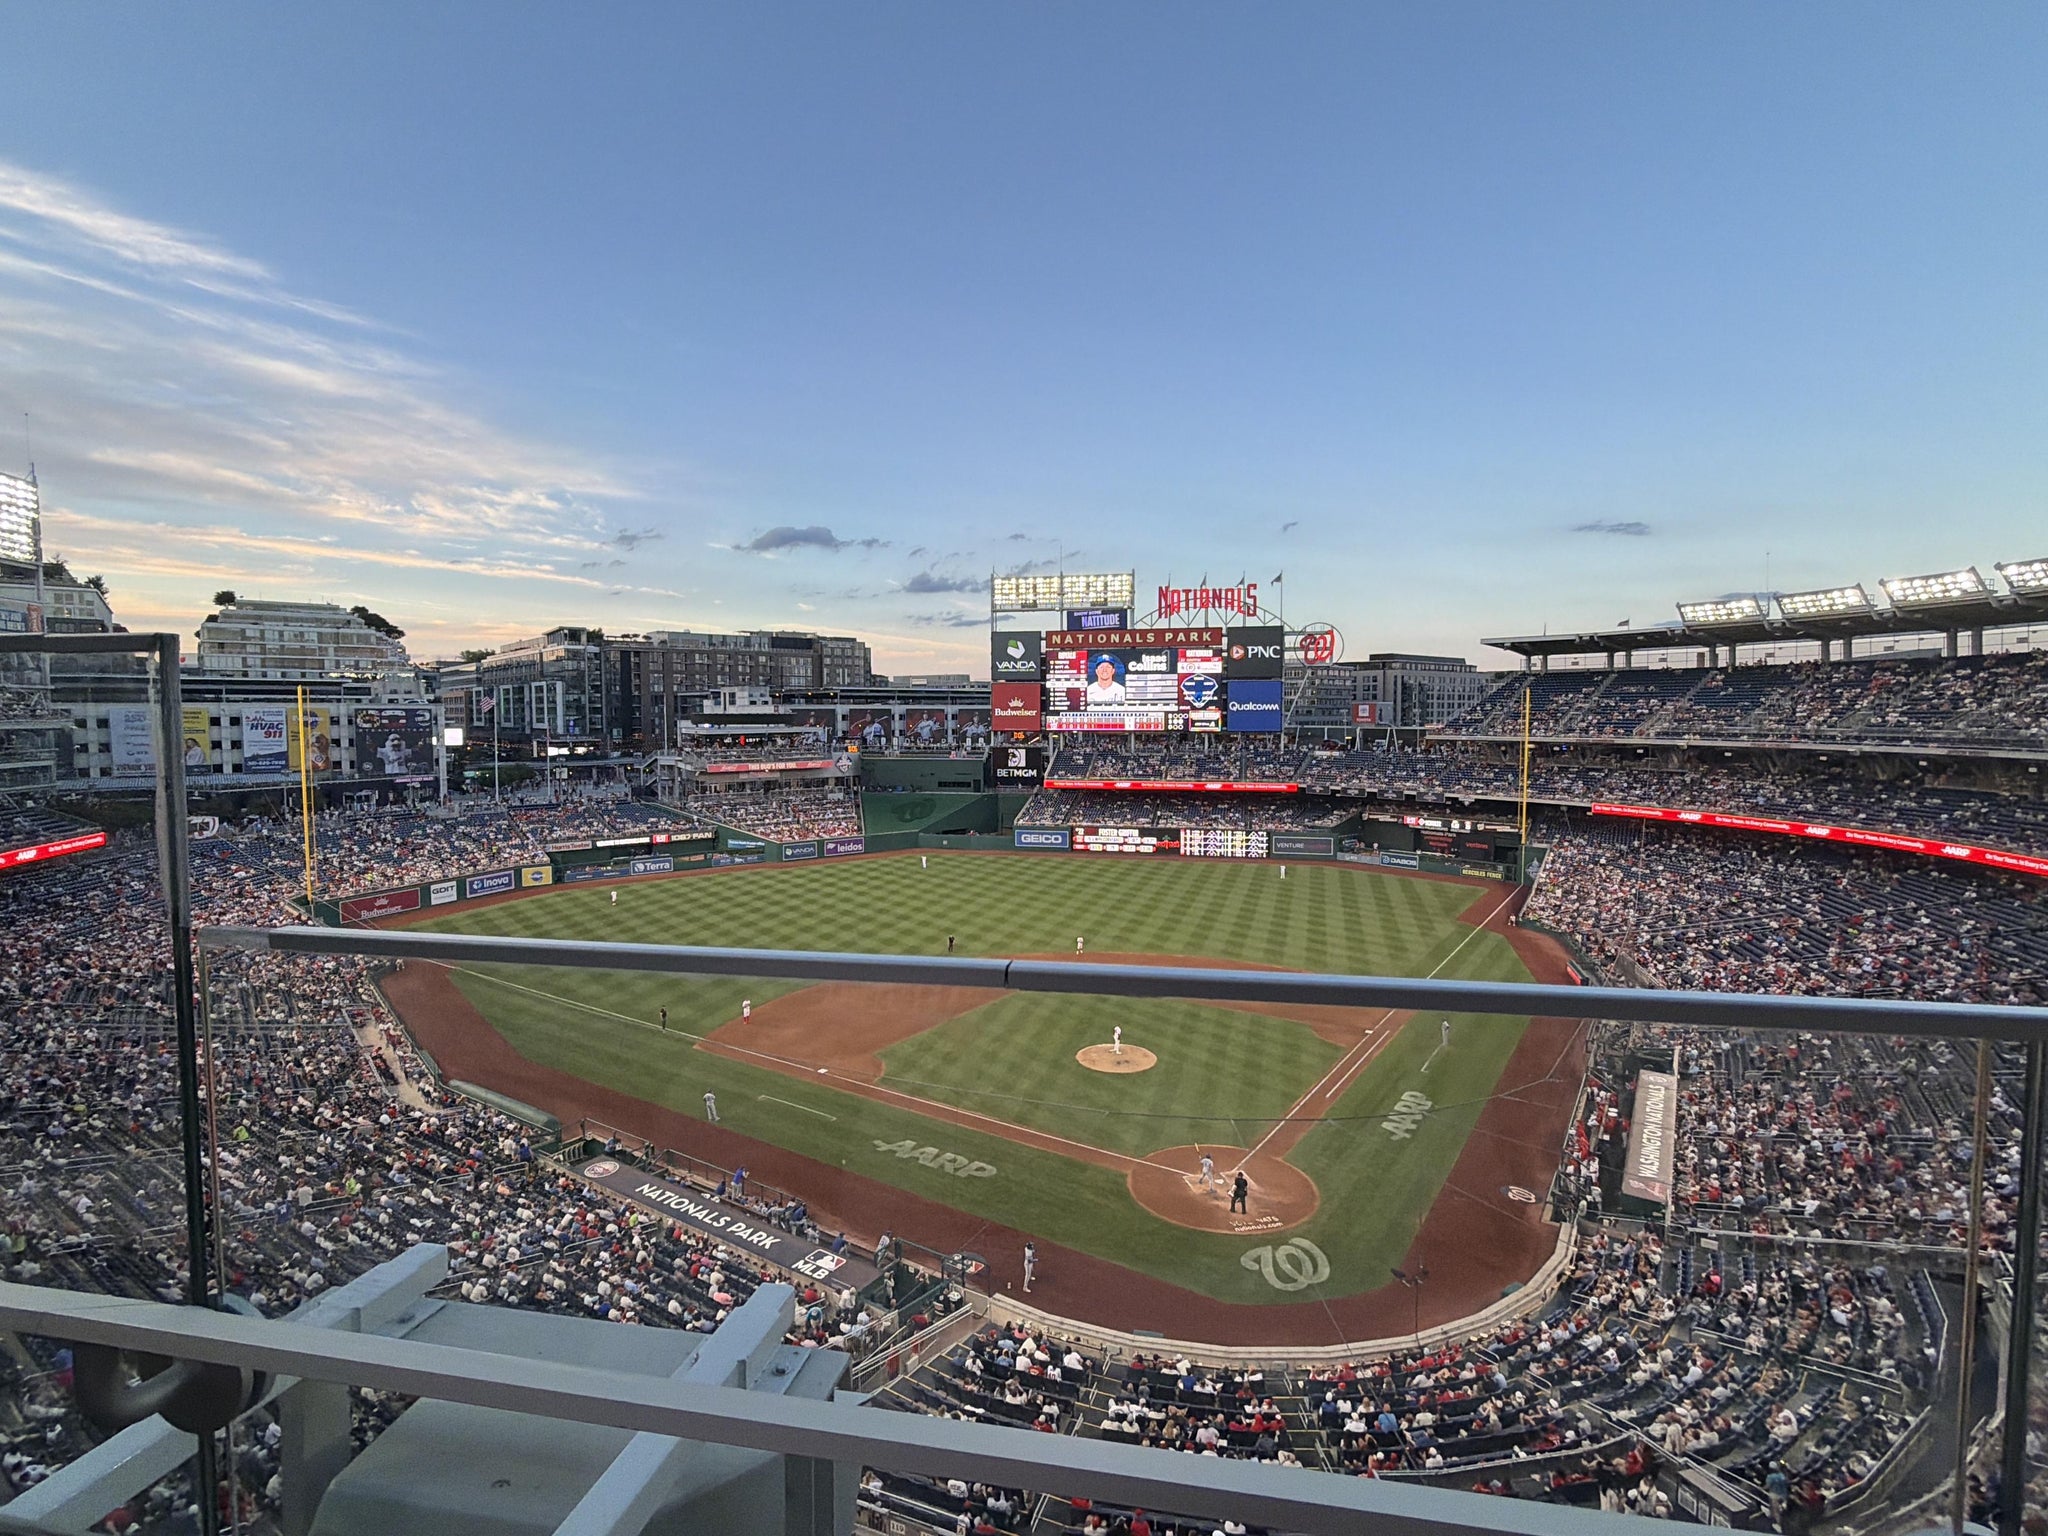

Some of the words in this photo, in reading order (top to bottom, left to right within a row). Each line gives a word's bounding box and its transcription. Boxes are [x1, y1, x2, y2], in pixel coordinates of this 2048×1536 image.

[1158, 583, 1257, 619] NATIONALS
[1081, 613, 1120, 628] NATITUDE
[1052, 633, 1156, 645] NATIONALS
[1165, 631, 1212, 642] PARK
[1247, 645, 1281, 659] PNC
[995, 660, 1037, 669] VANDA
[1127, 660, 1168, 672] Collins
[994, 708, 1038, 717] Budweiser
[1229, 701, 1280, 712] Qualcomm
[249, 722, 285, 731] HVAC
[263, 730, 283, 739] 911
[996, 768, 1038, 778] BETMGM
[692, 831, 713, 839] FAN
[1021, 833, 1063, 844] GEICO
[792, 846, 815, 854] VANDA
[837, 842, 863, 853] leidos
[1941, 845, 1971, 857] AARP
[645, 861, 671, 871] Terra
[483, 876, 509, 888] Inova
[431, 885, 456, 895] GDIT
[360, 905, 403, 919] Budweiser
[1644, 1084, 1666, 1124] NATIONALS
[1638, 1123, 1663, 1179] WASHINGTON
[872, 1139, 998, 1179] AARP
[634, 1182, 732, 1228] NATIONALS
[726, 1222, 782, 1250] PARK
[790, 1259, 830, 1280] MLB
